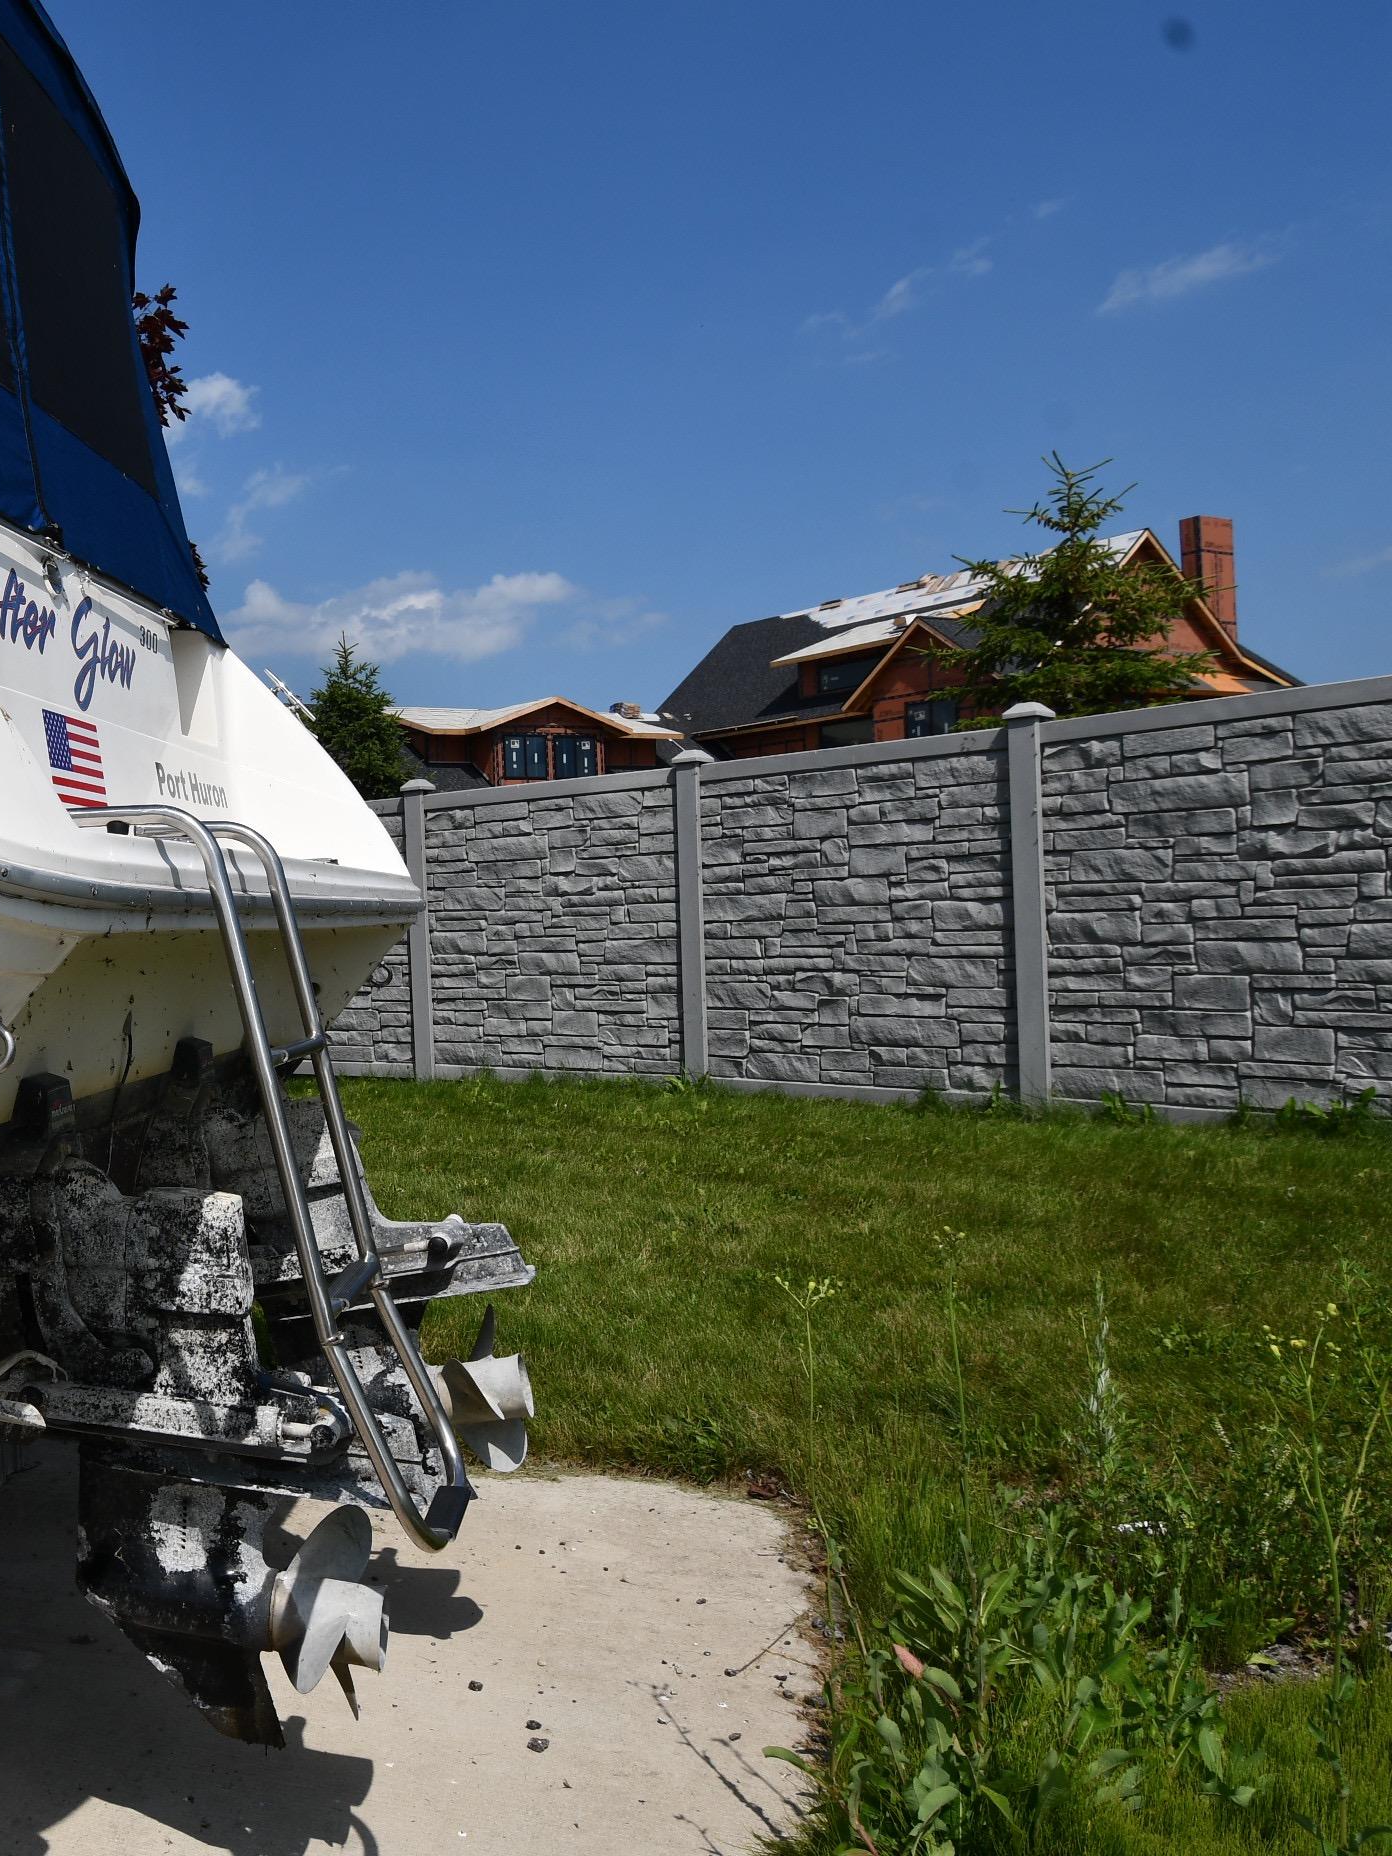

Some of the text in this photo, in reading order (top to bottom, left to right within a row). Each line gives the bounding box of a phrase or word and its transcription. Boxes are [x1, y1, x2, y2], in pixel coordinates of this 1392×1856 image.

[71, 596, 136, 711] Glow
[139, 624, 158, 654] 300
[154, 761, 229, 808] Port Huron
